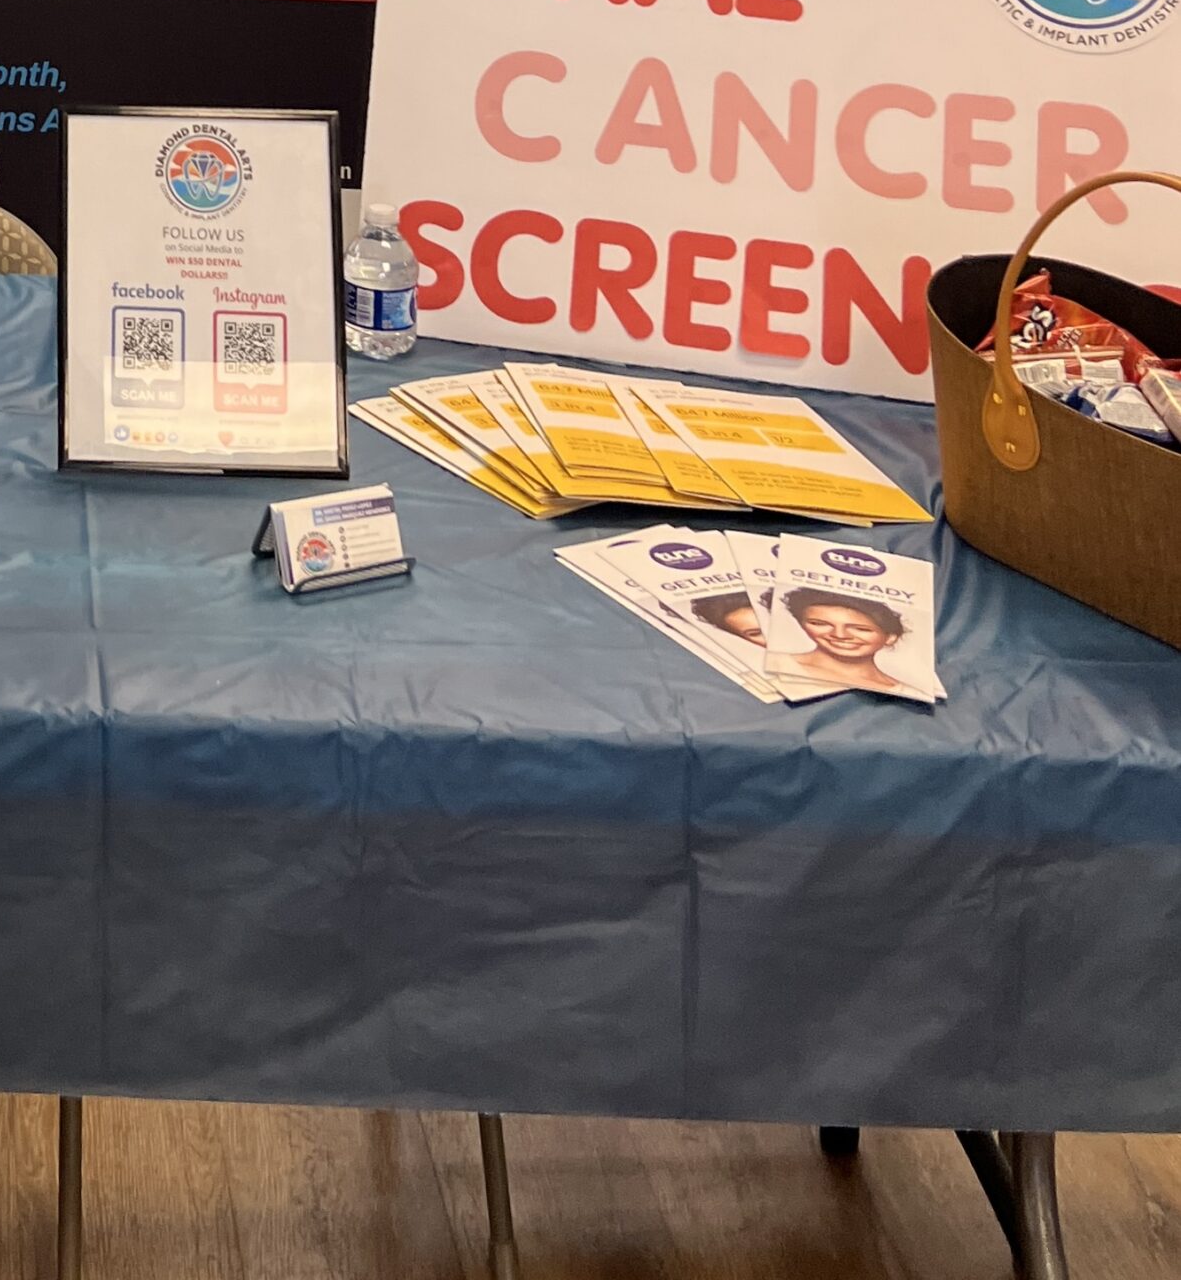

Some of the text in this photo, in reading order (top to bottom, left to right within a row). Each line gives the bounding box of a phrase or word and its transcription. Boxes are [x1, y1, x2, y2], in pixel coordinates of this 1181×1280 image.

[1023, 18, 1034, 30] &
[1037, 24, 1109, 47] IMPLANT
[474, 50, 1129, 225] CANCER
[155, 124, 253, 181] DIAMOND DENTAL ARTS
[162, 226, 245, 242] FOLLOW US
[178, 243, 203, 252] Social
[205, 245, 232, 254] Media
[234, 246, 244, 254] to
[166, 256, 242, 268] WIN $50 DENTAL
[111, 282, 185, 301] facebook
[213, 286, 287, 310] Instagram
[121, 389, 178, 402] SCAN ME
[222, 393, 259, 407] SCAN
[712, 409, 766, 422] Million
[654, 548, 702, 562] tune
[826, 552, 882, 570] tune
[661, 578, 697, 592] GET
[701, 572, 742, 585] REA
[790, 569, 832, 582] GET
[840, 579, 916, 599] READY
